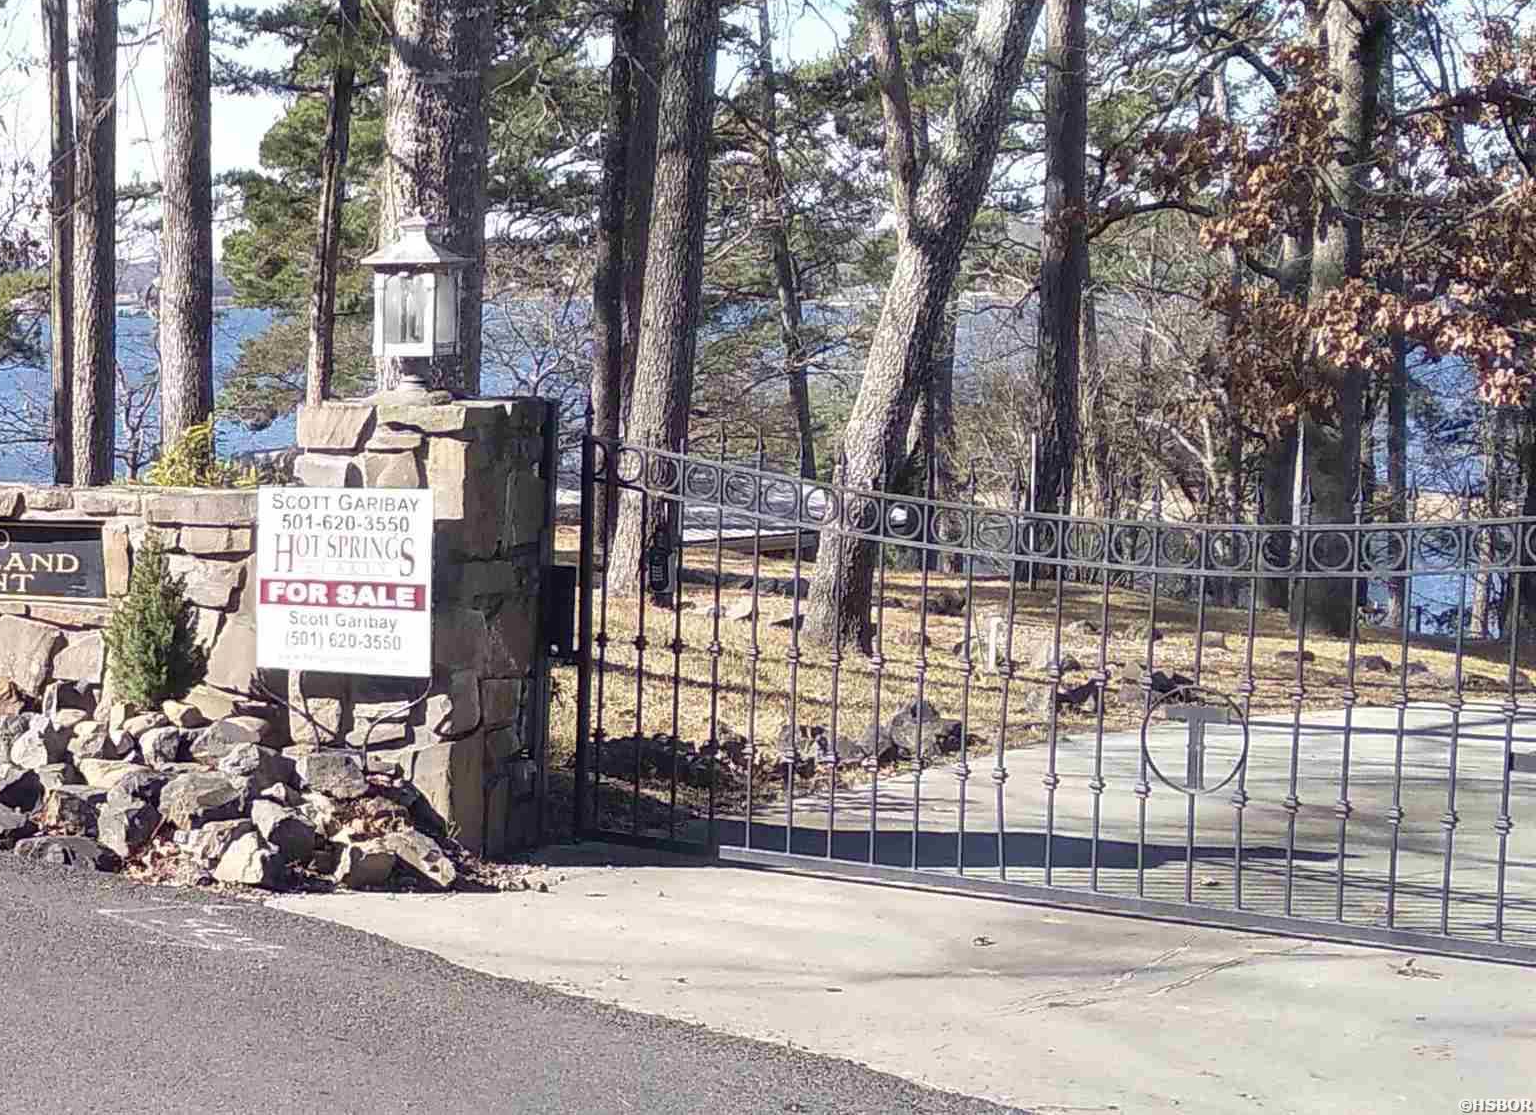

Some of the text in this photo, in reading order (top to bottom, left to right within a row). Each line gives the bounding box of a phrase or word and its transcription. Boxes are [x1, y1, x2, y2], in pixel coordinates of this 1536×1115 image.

[282, 514, 410, 533] 501-620-3550
[268, 582, 416, 607] FOR SALE
[289, 610, 398, 633] Scott Garibay
[285, 631, 402, 650] (501) 620-3550
